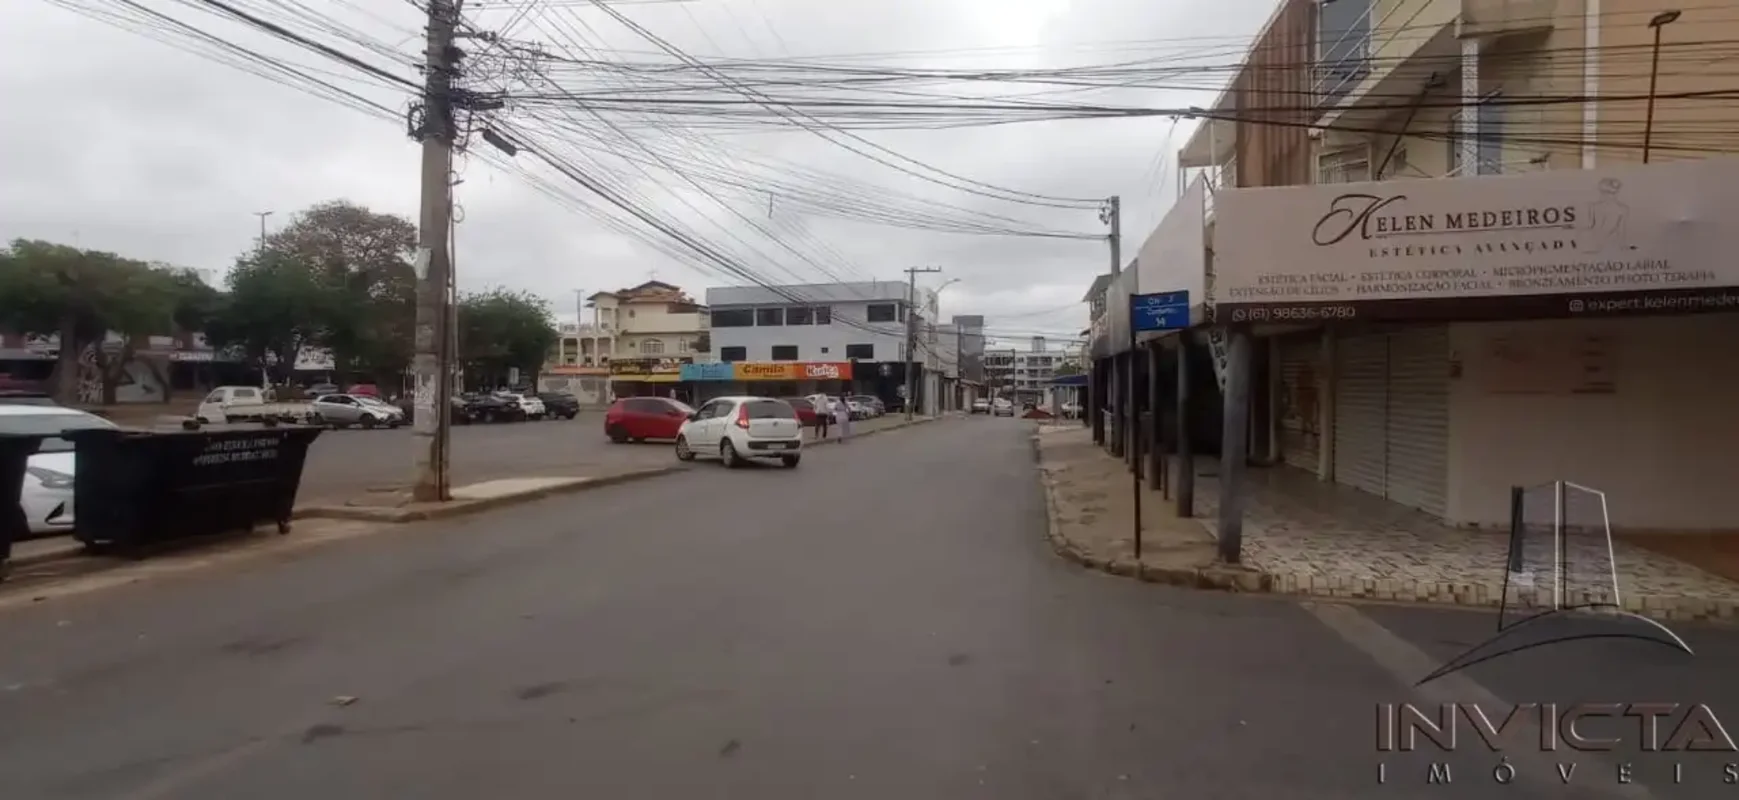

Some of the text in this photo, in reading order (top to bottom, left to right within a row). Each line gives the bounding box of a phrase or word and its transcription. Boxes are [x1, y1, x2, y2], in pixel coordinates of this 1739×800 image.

[1446, 207, 1576, 230] MEDEIROS
[1310, 272, 1347, 283] FACIAL
[1272, 306, 1356, 319] 98636-6780
